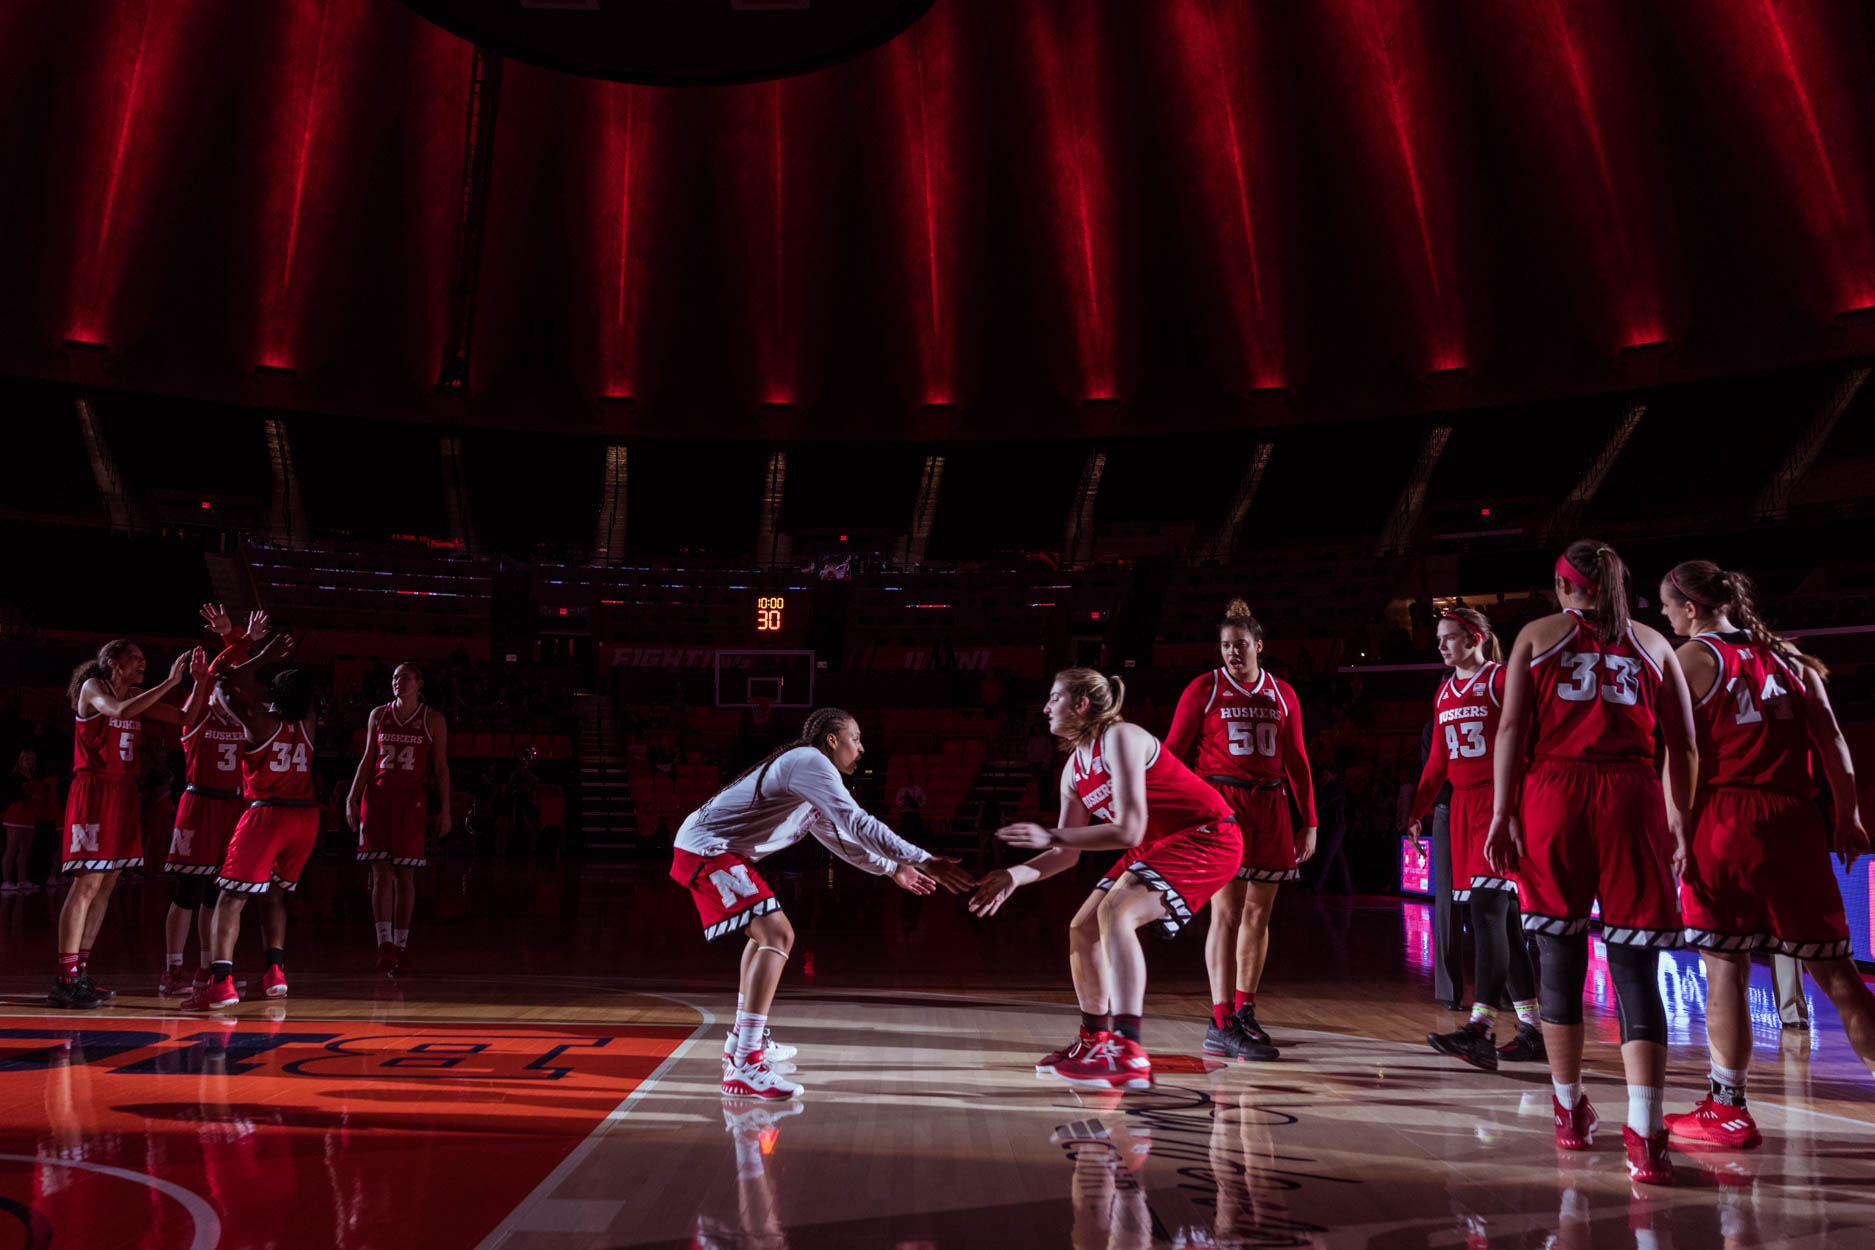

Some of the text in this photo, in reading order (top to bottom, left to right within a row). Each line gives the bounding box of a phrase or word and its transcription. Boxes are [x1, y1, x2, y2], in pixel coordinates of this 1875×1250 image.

[757, 597, 784, 610] 10:00
[757, 610, 781, 631] 30
[1557, 650, 1642, 707] 33
[1220, 707, 1281, 721] HUSKERS
[1726, 673, 1795, 725] 14
[119, 731, 135, 762] 5
[204, 729, 246, 741] HUSKER
[378, 732, 423, 746] HUSKERS
[1227, 721, 1278, 757] 50
[1445, 720, 1487, 760] 43
[217, 743, 238, 772] 3
[269, 741, 308, 773] 34
[379, 744, 416, 771] 24
[69, 823, 100, 854] N
[168, 828, 196, 857] N
[708, 864, 760, 909] N
